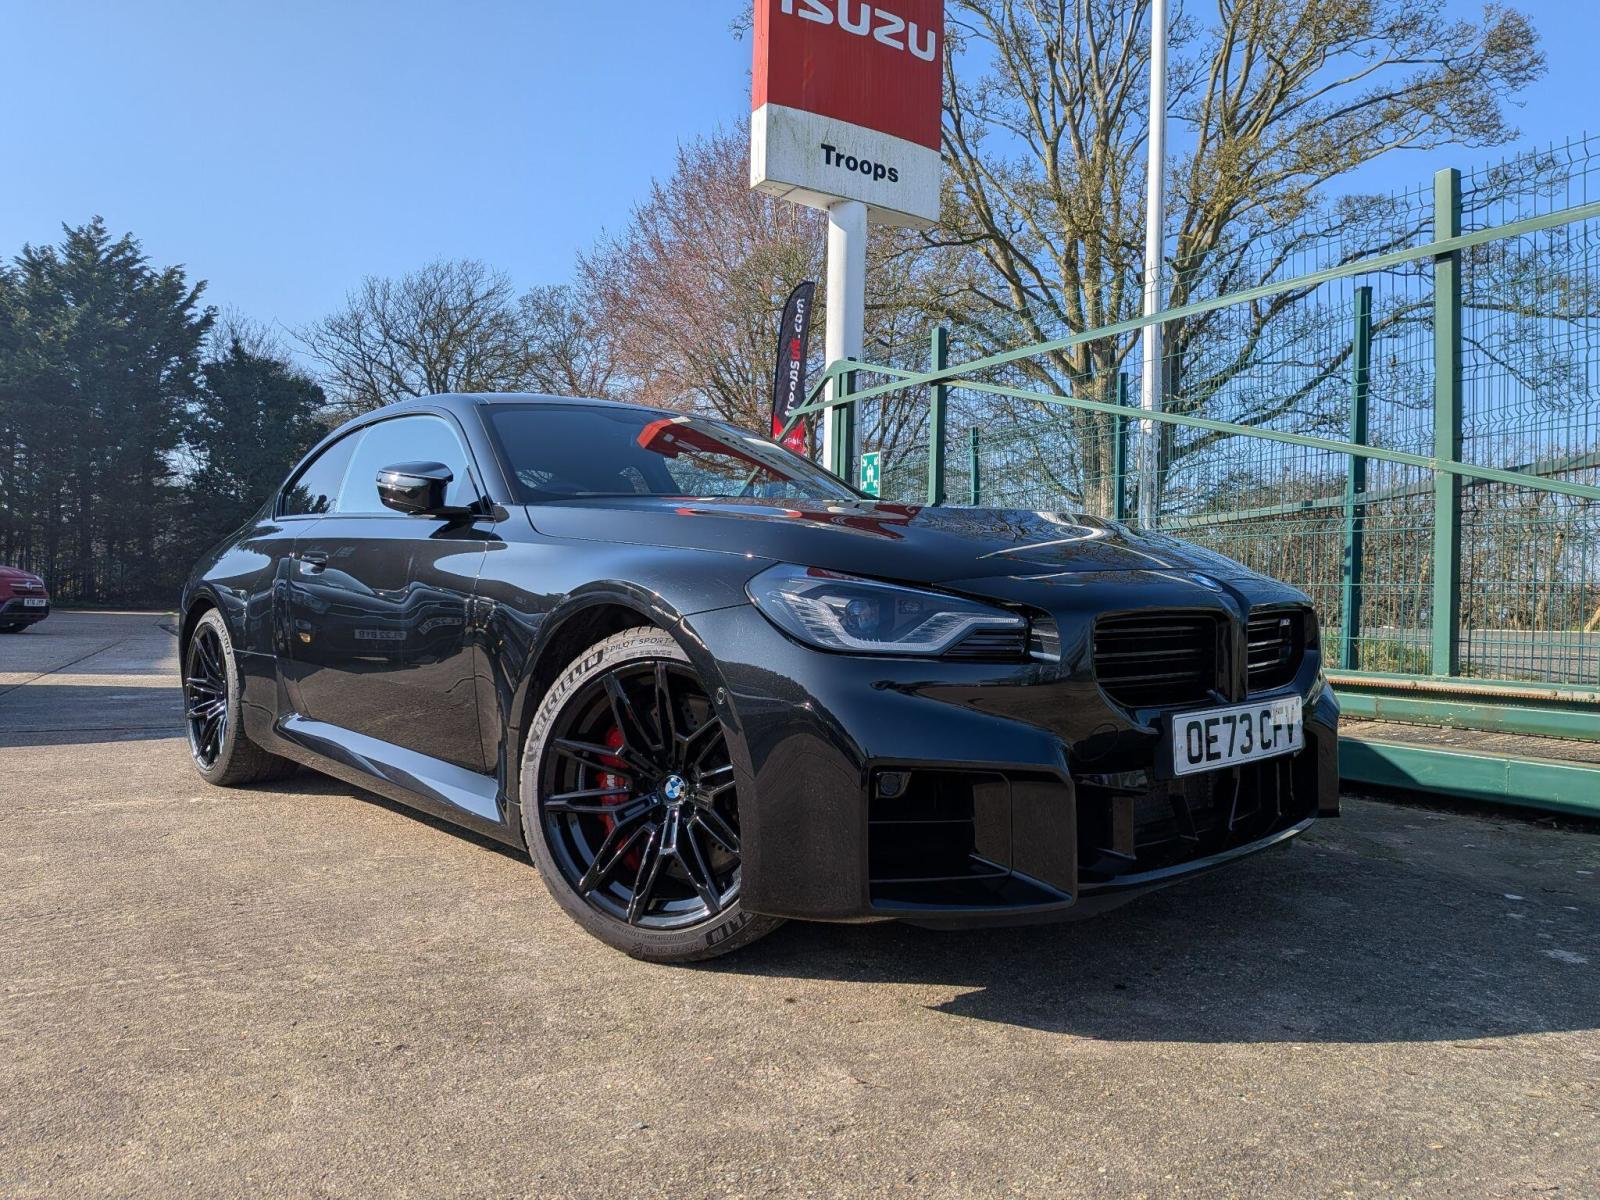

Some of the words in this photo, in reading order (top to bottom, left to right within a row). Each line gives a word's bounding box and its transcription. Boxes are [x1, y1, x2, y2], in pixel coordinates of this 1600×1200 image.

[820, 143, 899, 183] Troops
[610, 640, 635, 653] PILOT
[639, 637, 671, 646] SPORT
[1186, 713, 1254, 765] OE73
